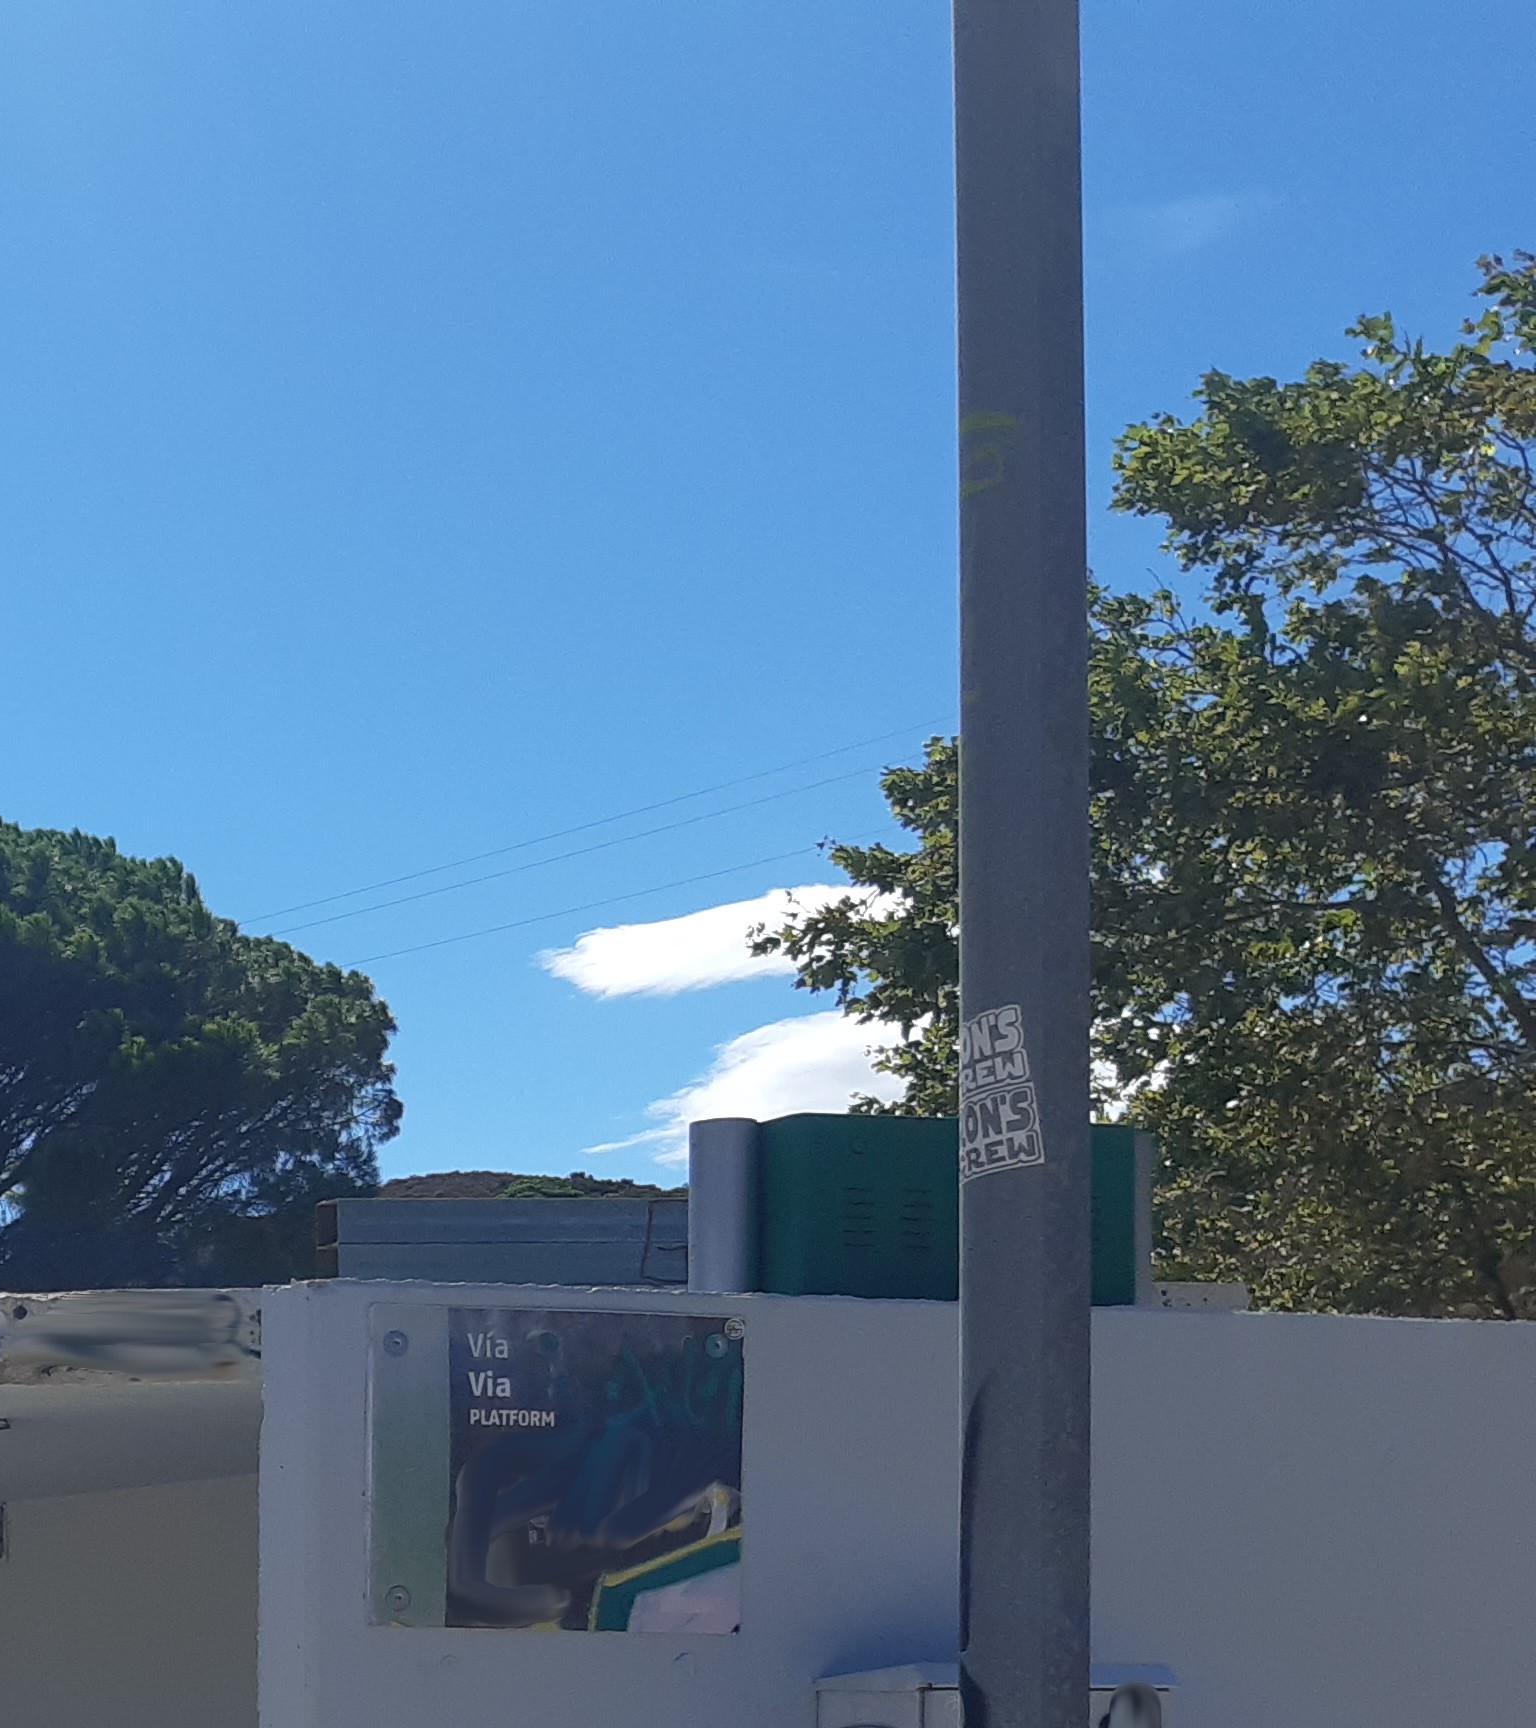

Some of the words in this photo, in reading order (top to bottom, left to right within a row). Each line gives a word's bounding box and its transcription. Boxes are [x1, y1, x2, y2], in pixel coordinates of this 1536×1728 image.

[962, 1090, 1031, 1147] ON'S
[466, 1330, 509, 1359] Vía
[468, 1370, 512, 1398] Via
[469, 1408, 556, 1428] PLATFORM
